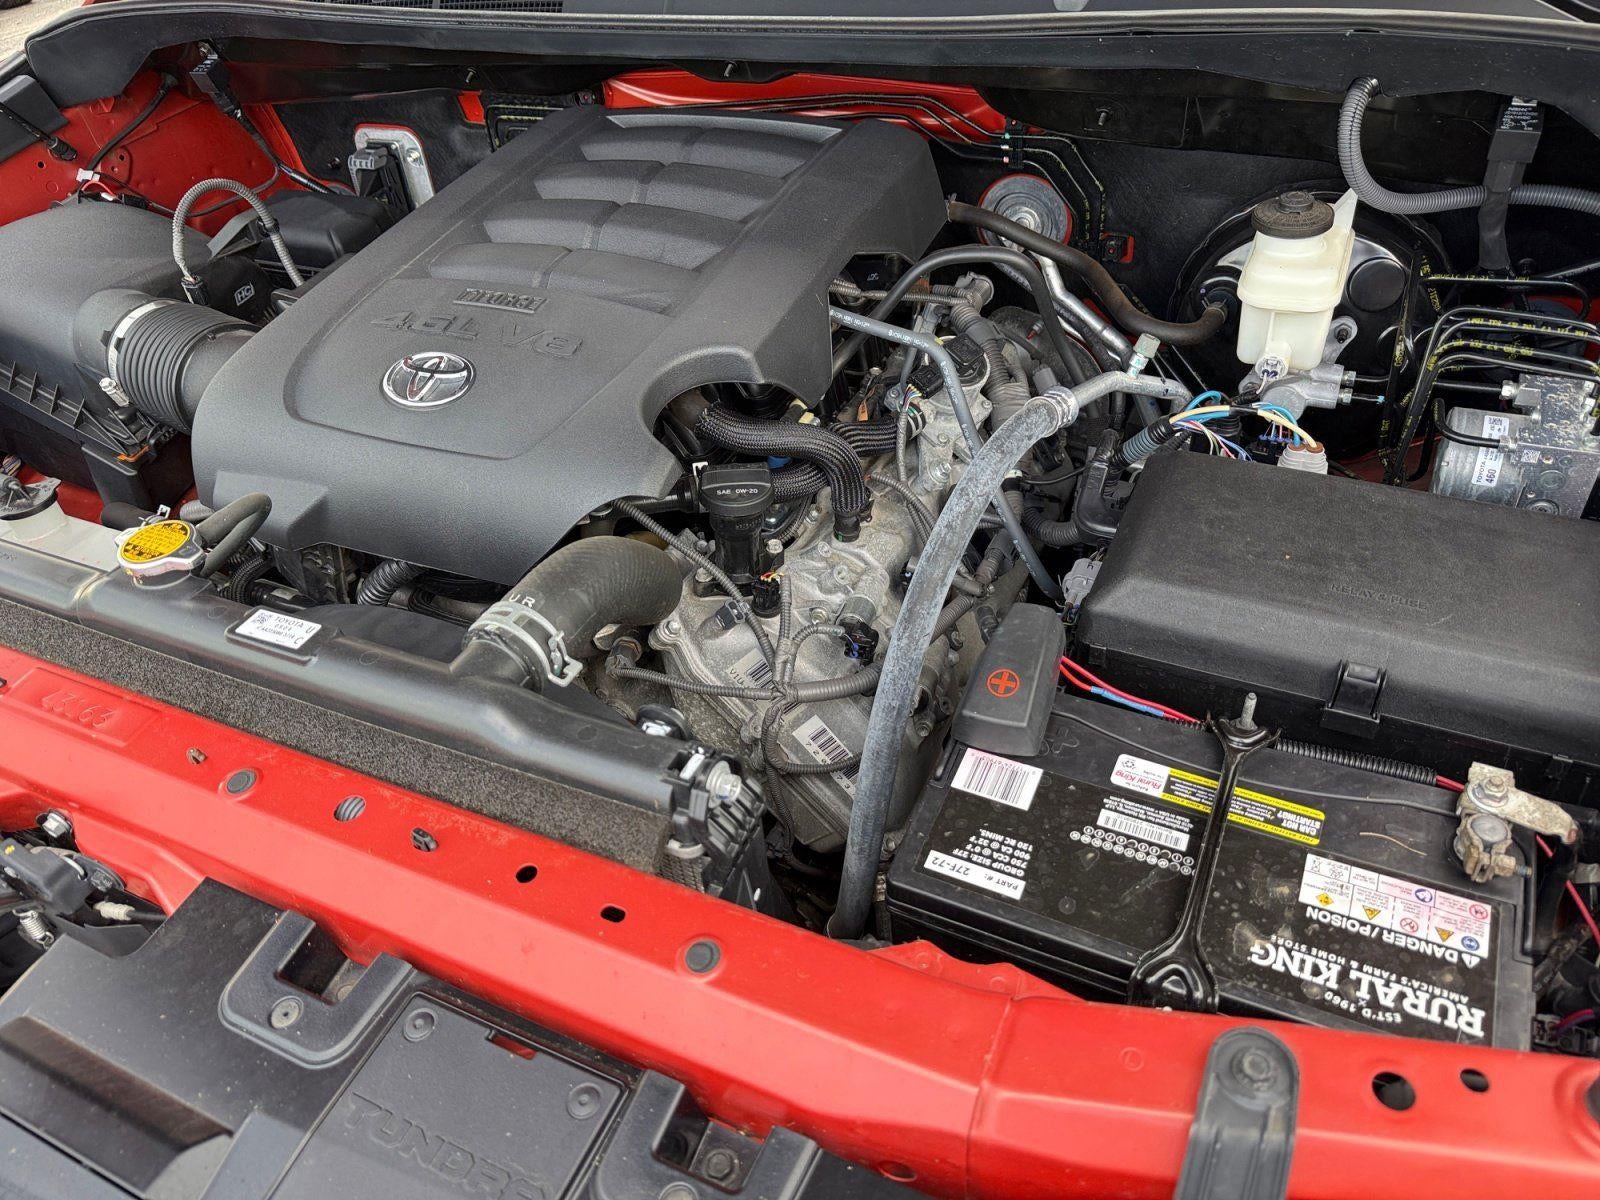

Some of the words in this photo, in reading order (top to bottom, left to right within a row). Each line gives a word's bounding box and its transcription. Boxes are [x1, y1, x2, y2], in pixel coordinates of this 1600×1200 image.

[1476, 461, 1486, 483] TOYOTA
[1486, 469, 1497, 484] 460
[274, 615, 304, 628] TOYOTA
[1114, 769, 1135, 781] King
[1277, 810, 1321, 828] STARTING?
[1281, 819, 1298, 831] NOT
[979, 828, 1004, 842] MINS.
[1299, 824, 1316, 836] CAR
[990, 841, 1000, 849] @
[1004, 835, 1015, 845] RC
[1015, 840, 1033, 852] 120
[952, 848, 969, 859] 27F
[981, 847, 992, 856] @
[1001, 844, 1013, 853] CA
[1013, 849, 1031, 860] 900
[970, 854, 992, 866] SIZE:
[992, 851, 1009, 864] CCA
[1010, 858, 1028, 869] 750
[931, 856, 971, 876] 27F-72
[991, 861, 1025, 877] GROUP
[995, 878, 1019, 891] PART
[1306, 905, 1372, 937] POISON
[1270, 934, 1308, 952] STORE
[1382, 929, 1458, 963] DANGER
[1310, 947, 1346, 965] HOME
[1250, 939, 1342, 990] KING
[1349, 960, 1359, 969] &
[1362, 963, 1397, 981] FARM
[1400, 976, 1469, 1004] AMERICA'S
[1324, 990, 1357, 1013] 1960
[1349, 968, 1486, 1038] RURAL
[1361, 1007, 1402, 1023] EST'D
